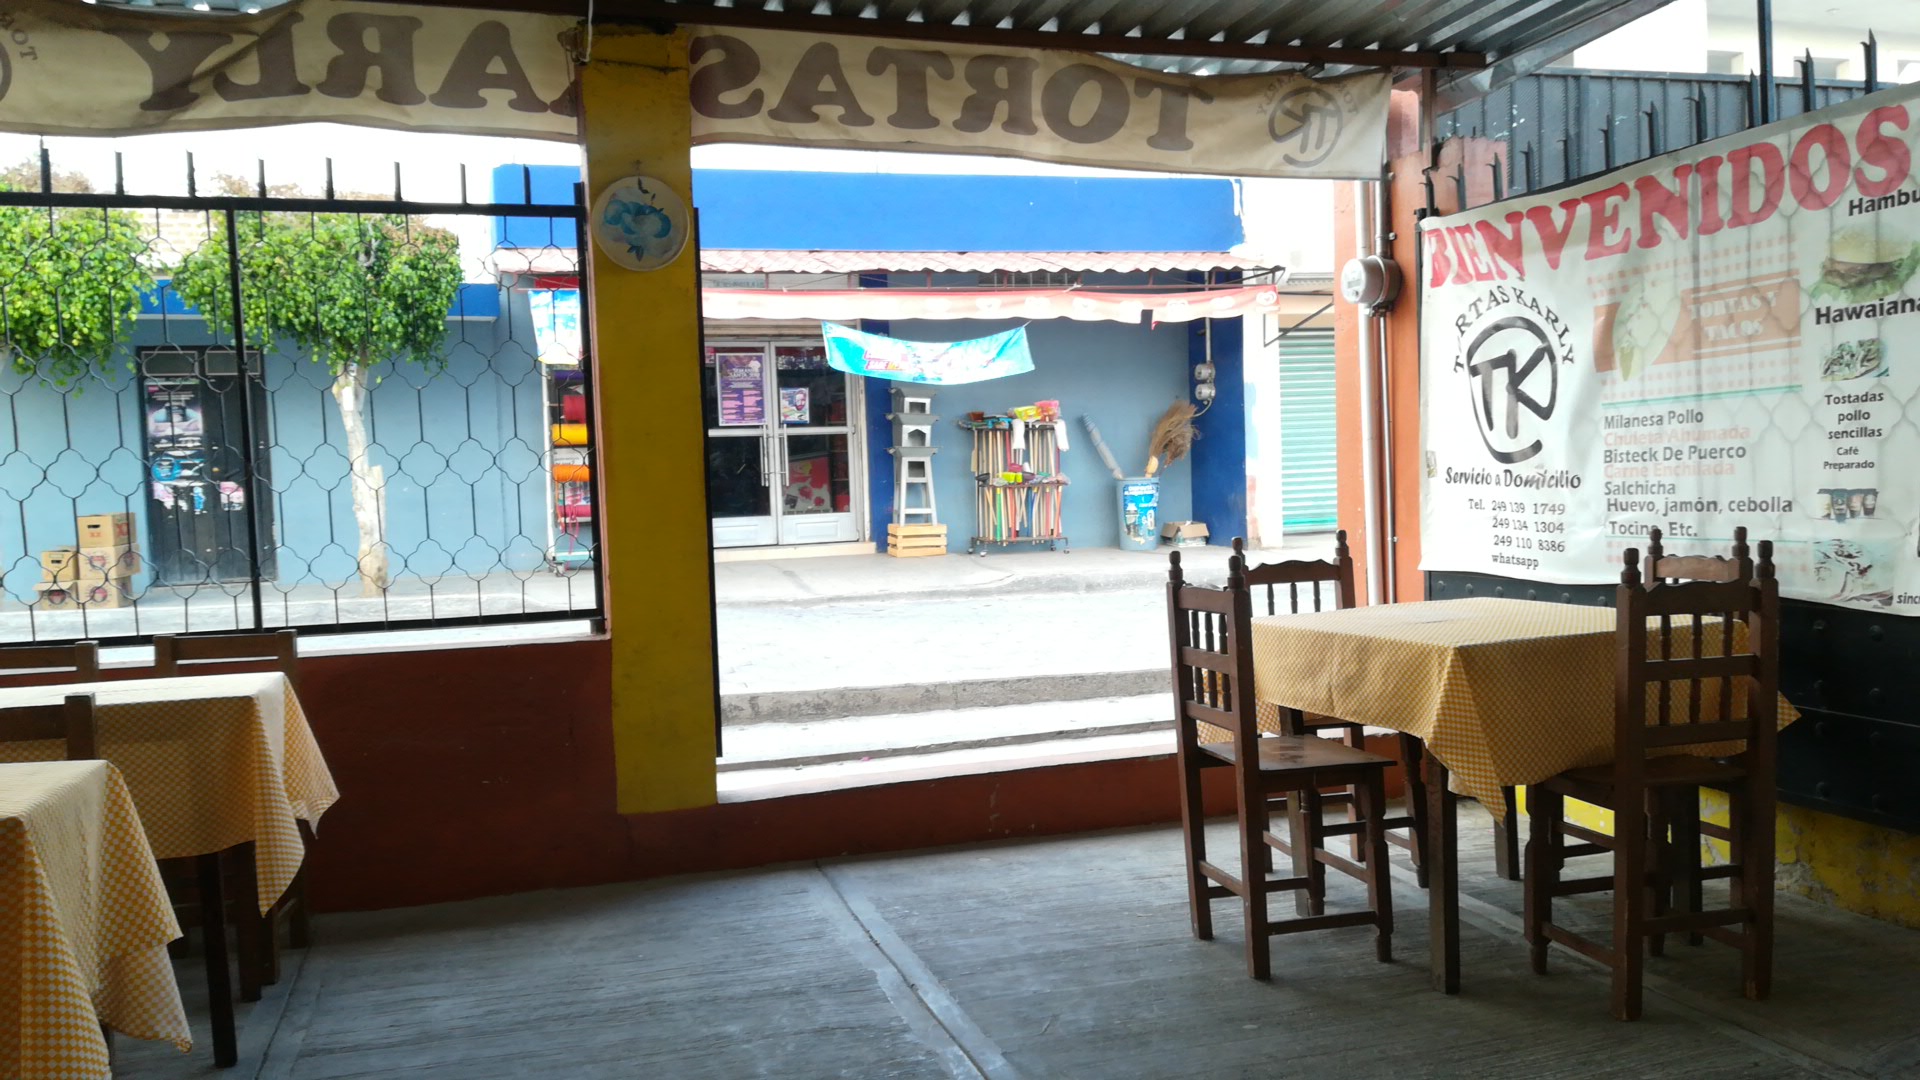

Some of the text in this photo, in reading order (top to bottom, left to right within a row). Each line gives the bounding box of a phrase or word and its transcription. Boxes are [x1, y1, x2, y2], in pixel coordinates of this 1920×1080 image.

[1423, 104, 1911, 289] BIENVENIDOS
[1824, 391, 1884, 405] Tostadas
[1604, 409, 1704, 430] Milanesa Pollo
[1837, 409, 1871, 425] pollo
[1604, 425, 1751, 447] Chuleta Ahumada
[1828, 426, 1883, 440] sencillas
[1603, 445, 1747, 464] Bisteck De Puerco
[1836, 445, 1860, 456] Café
[1604, 461, 1736, 479] Carne Enchilada
[1823, 460, 1875, 471] Preparado
[1445, 466, 1582, 491] Servicio a Domicilio
[1604, 480, 1676, 496] Salchicha
[1468, 499, 1566, 516] Tel. 249 139 1749
[1607, 496, 1793, 517] Huevo, jamón, cebolla
[1492, 517, 1565, 534] 249 134 1304
[1668, 522, 1698, 537] Etc.
[1493, 534, 1566, 553] 249 110 8386
[1491, 552, 1540, 571] whatsapp
